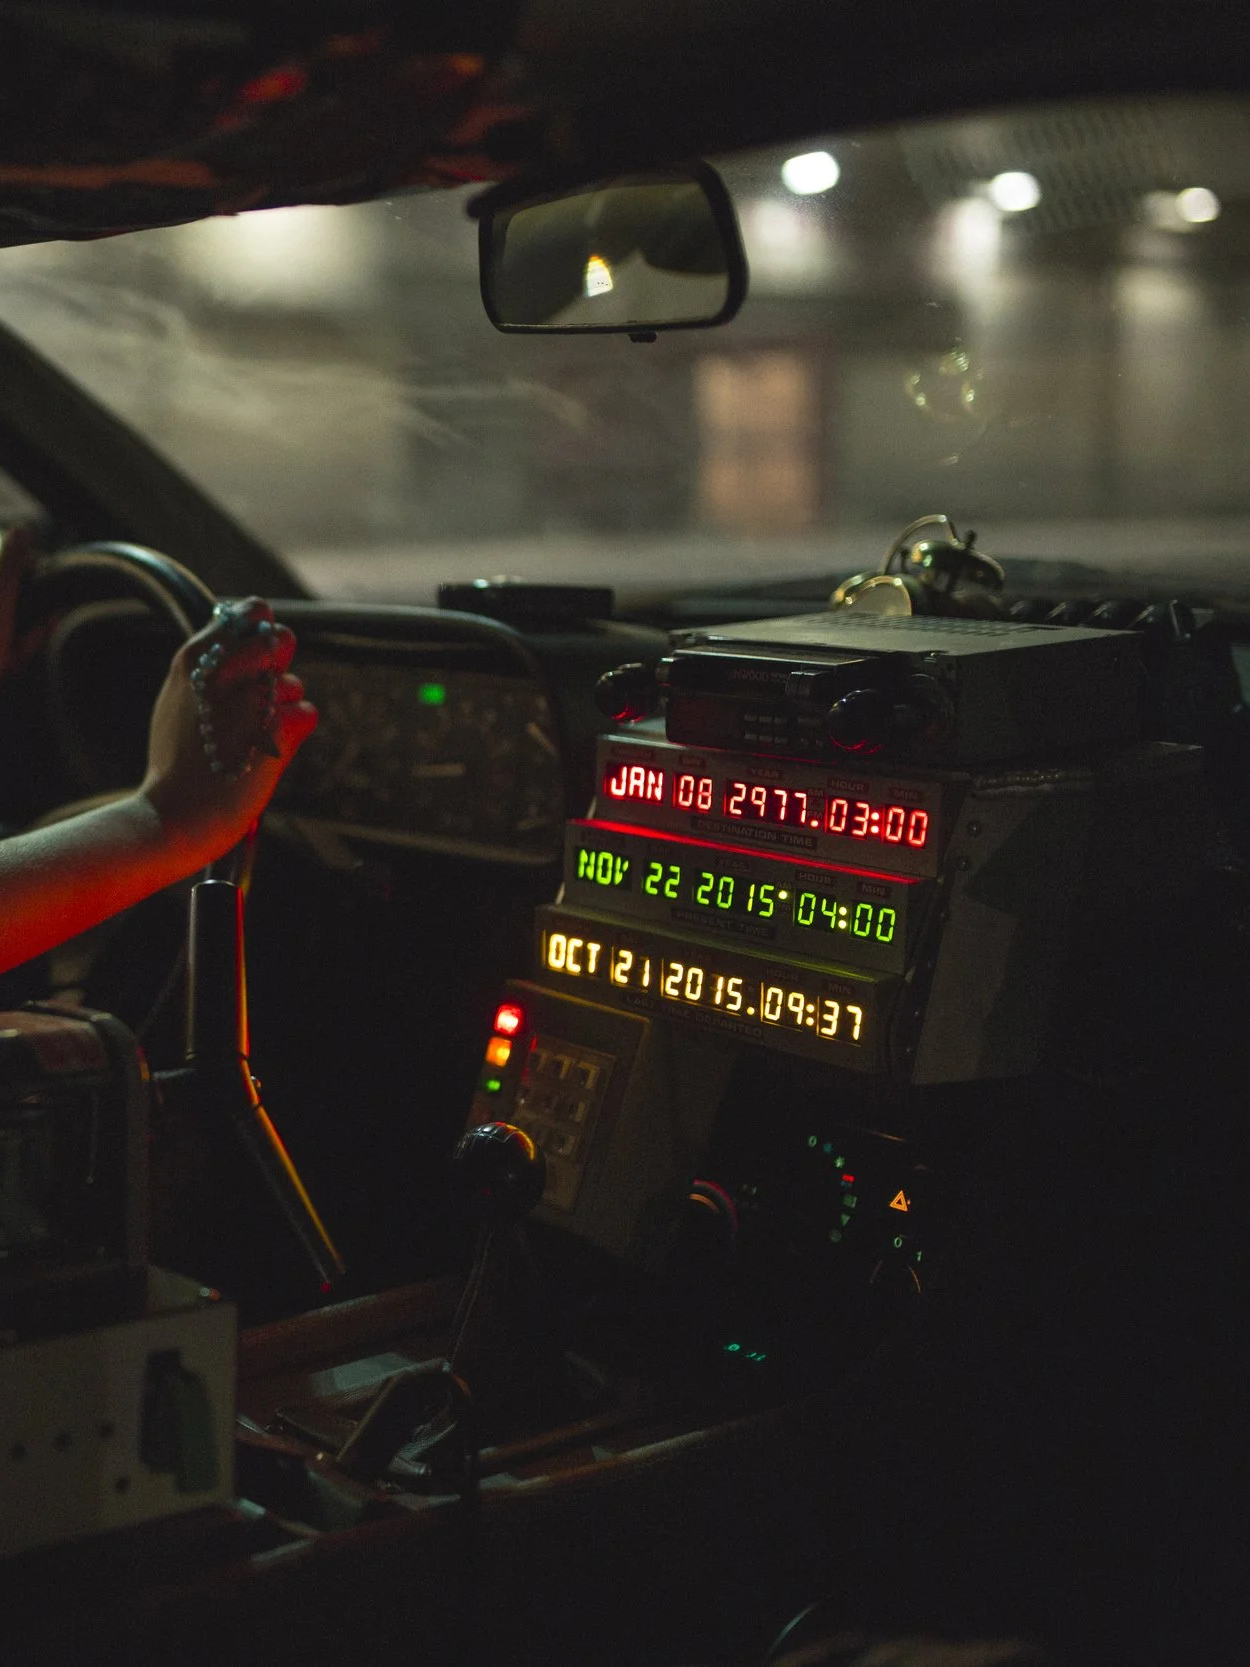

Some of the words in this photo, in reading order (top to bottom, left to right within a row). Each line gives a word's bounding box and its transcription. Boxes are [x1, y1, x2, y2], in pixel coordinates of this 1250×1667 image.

[608, 765, 665, 802] JAN
[676, 774, 713, 814] 08
[749, 768, 779, 779] YEAR
[830, 779, 865, 792] HOUR
[893, 789, 918, 800] MIN
[696, 818, 777, 842] DESTINATION
[782, 833, 813, 848] TIME
[577, 849, 630, 886] NOV
[644, 862, 682, 899] 22
[799, 872, 832, 884] HOUR
[861, 883, 886, 894] MIN
[676, 910, 733, 929] PRESENT
[738, 922, 770, 937] TIME
[547, 933, 602, 976] OCT
[614, 949, 651, 989] 21
[766, 968, 799, 982] HOUR
[827, 982, 852, 994] MIN
